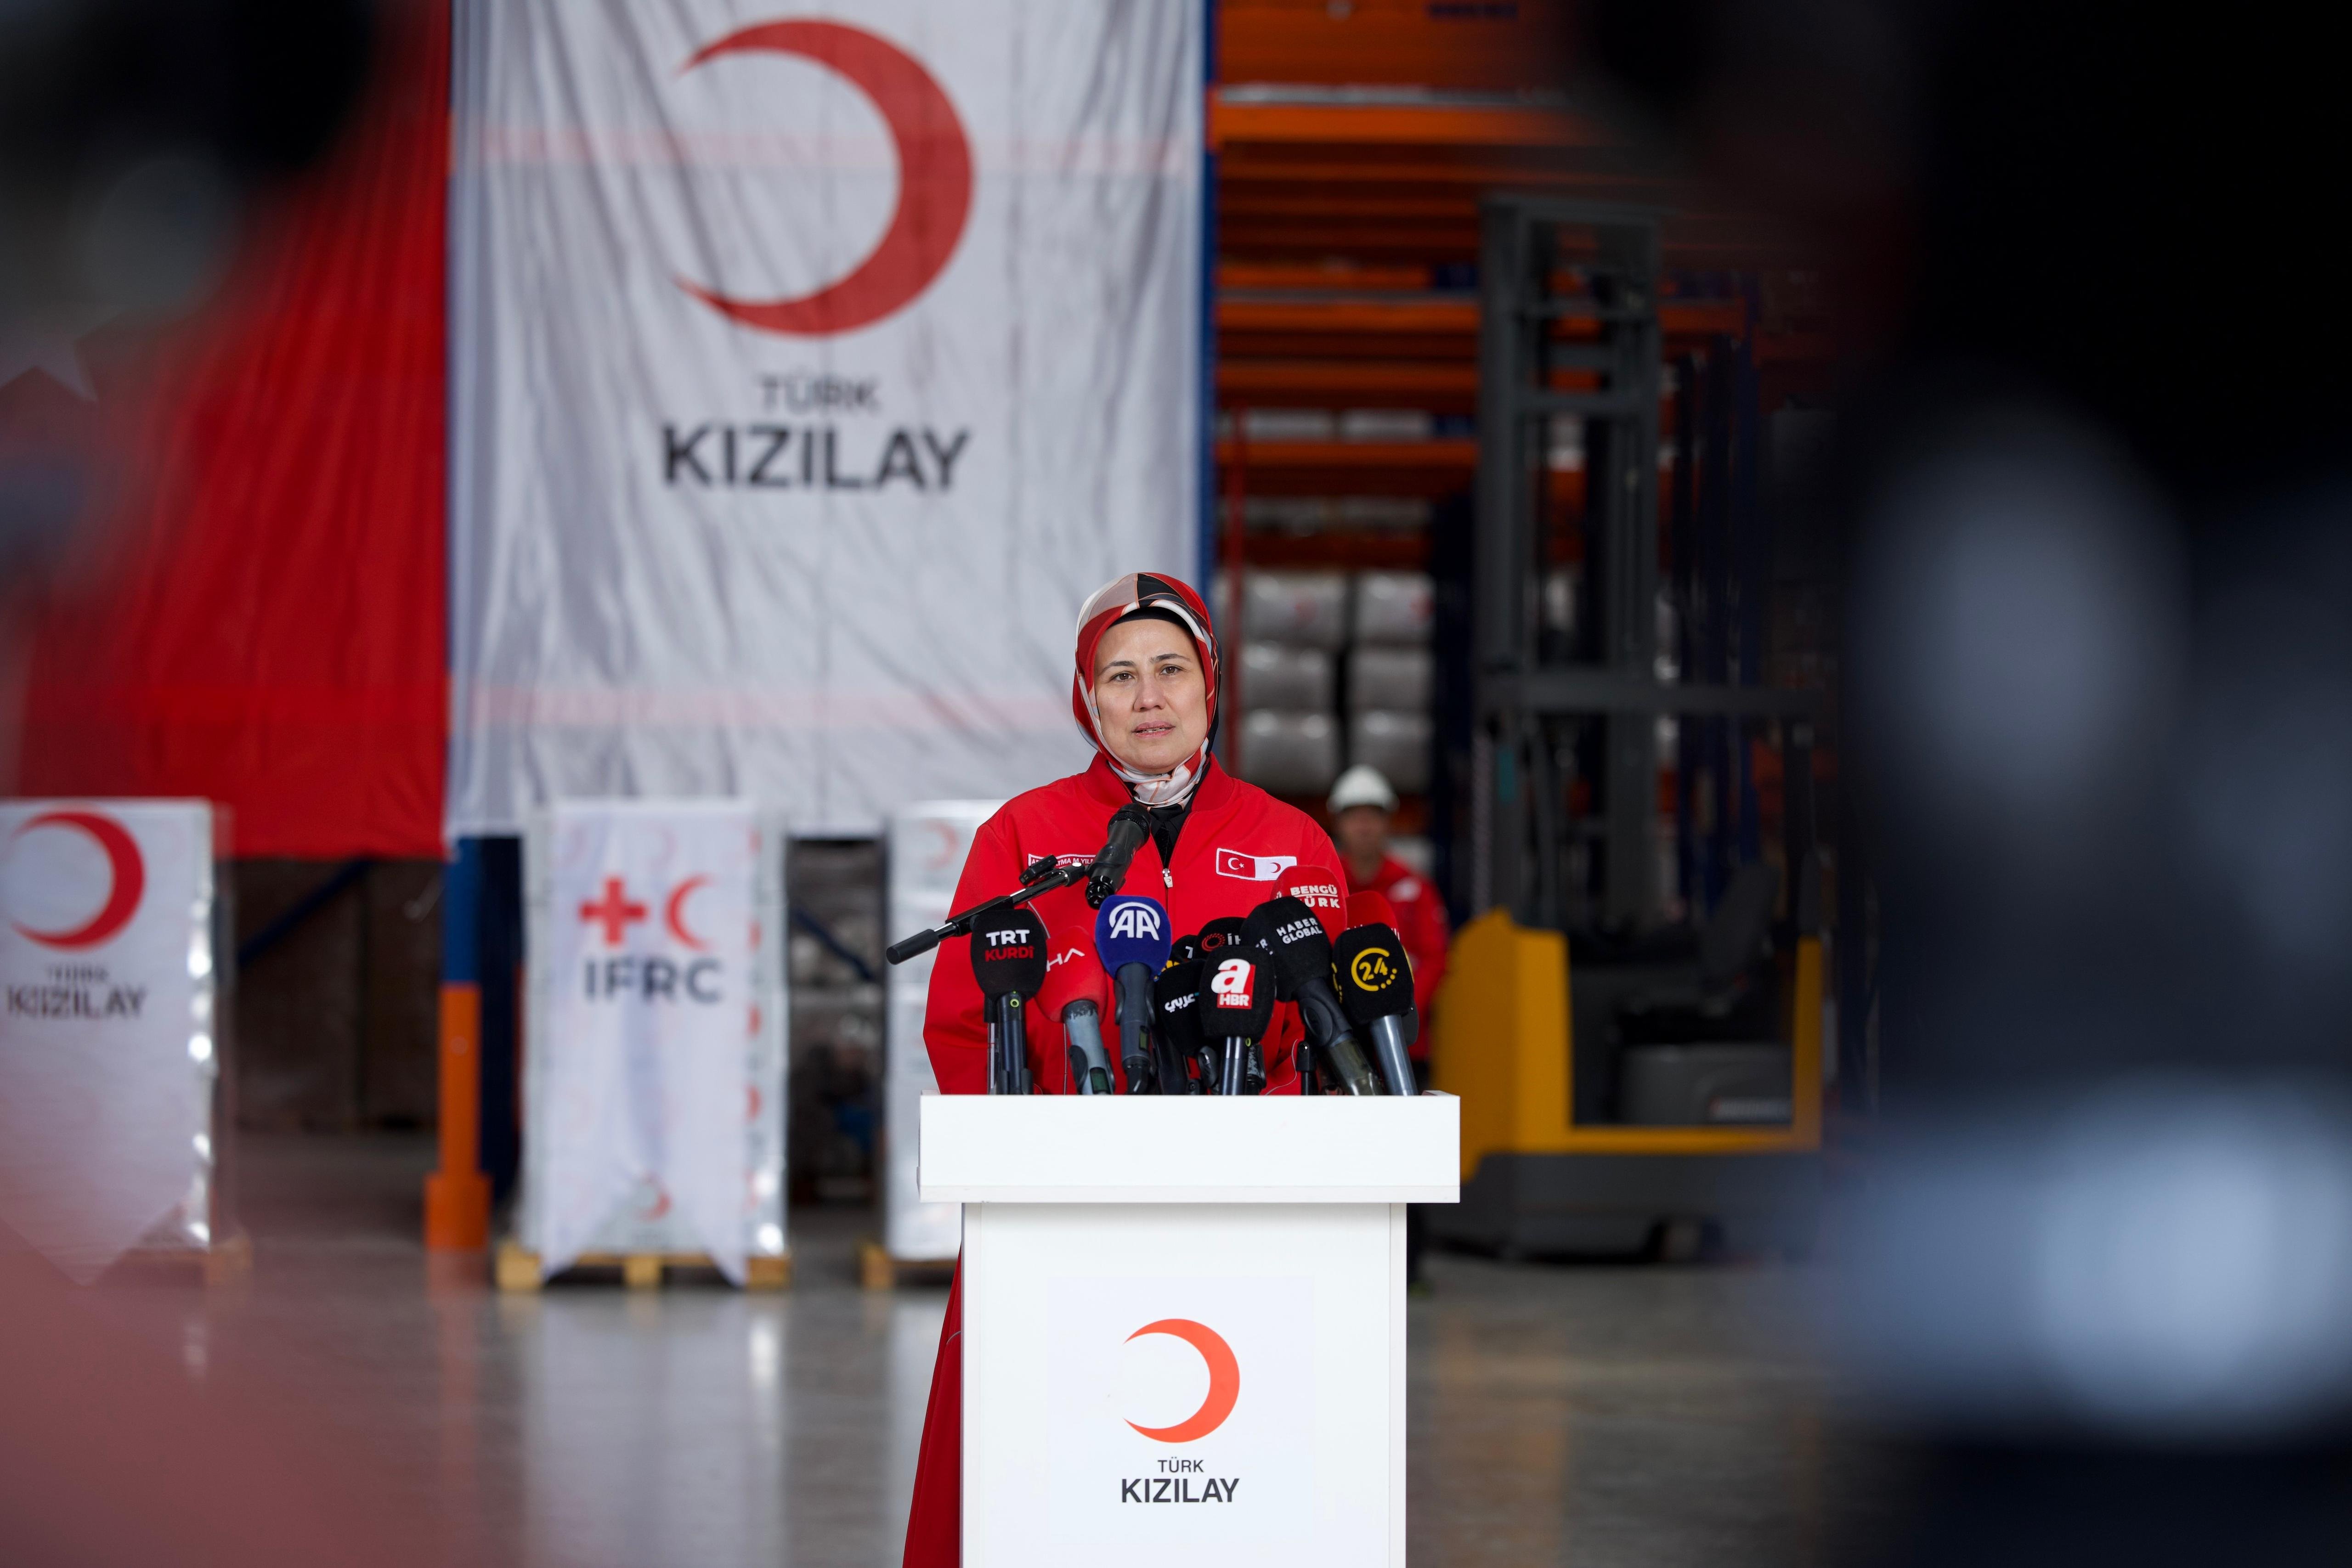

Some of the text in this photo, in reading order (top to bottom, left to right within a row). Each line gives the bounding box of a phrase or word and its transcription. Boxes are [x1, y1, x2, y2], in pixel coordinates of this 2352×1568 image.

[663, 423, 971, 491] KIZILAY
[1290, 884, 1338, 896] BENGÜ
[1300, 896, 1340, 908] ÜRK
[1110, 909, 1160, 941] AA
[1276, 918, 1318, 936] HABER
[1282, 925, 1323, 944] GLOBAL
[986, 929, 1030, 947] TRT
[1211, 958, 1250, 994] a
[1359, 957, 1388, 981] 24
[584, 957, 726, 1005] IFRC
[1219, 994, 1250, 1006] HBR
[1158, 1456, 1204, 1473] TÜRK
[1122, 1478, 1240, 1503] KIZILAY
